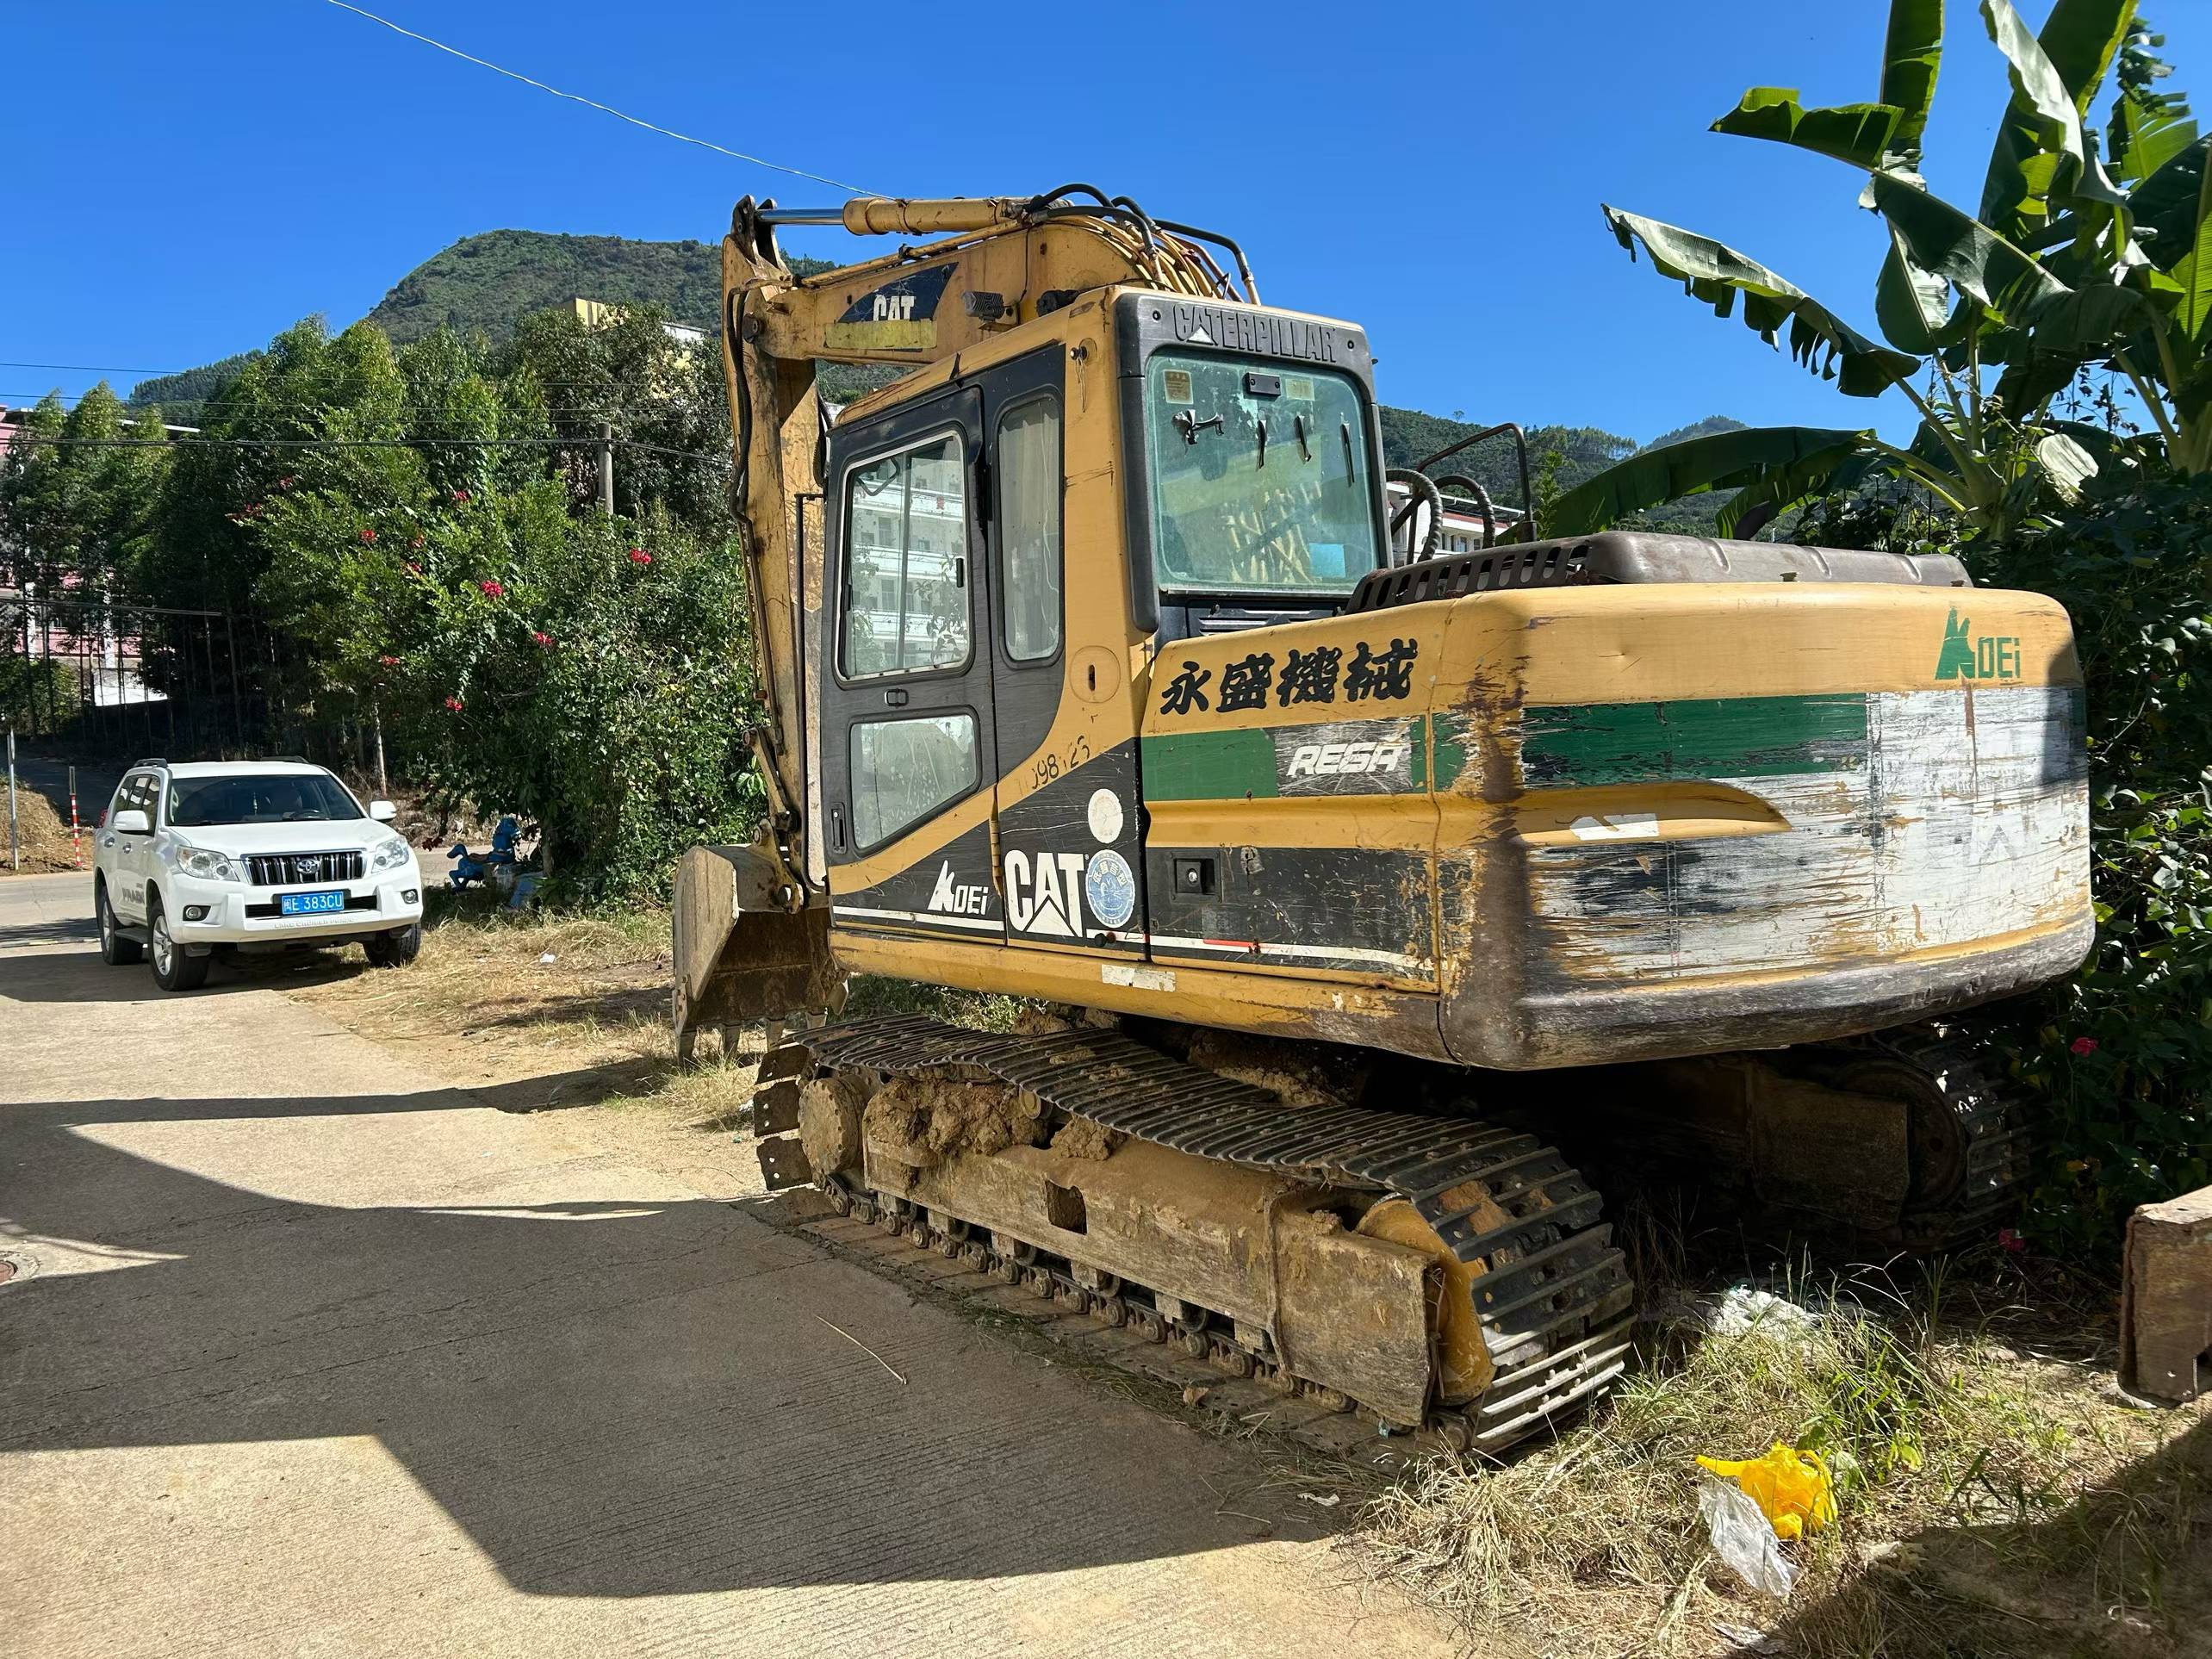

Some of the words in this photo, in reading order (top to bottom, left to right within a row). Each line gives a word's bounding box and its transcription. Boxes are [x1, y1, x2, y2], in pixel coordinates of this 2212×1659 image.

[1172, 301, 1338, 363] CATERPILLAR
[1159, 637, 1419, 715] 永盛機械
[1004, 849, 1085, 938] CAT
